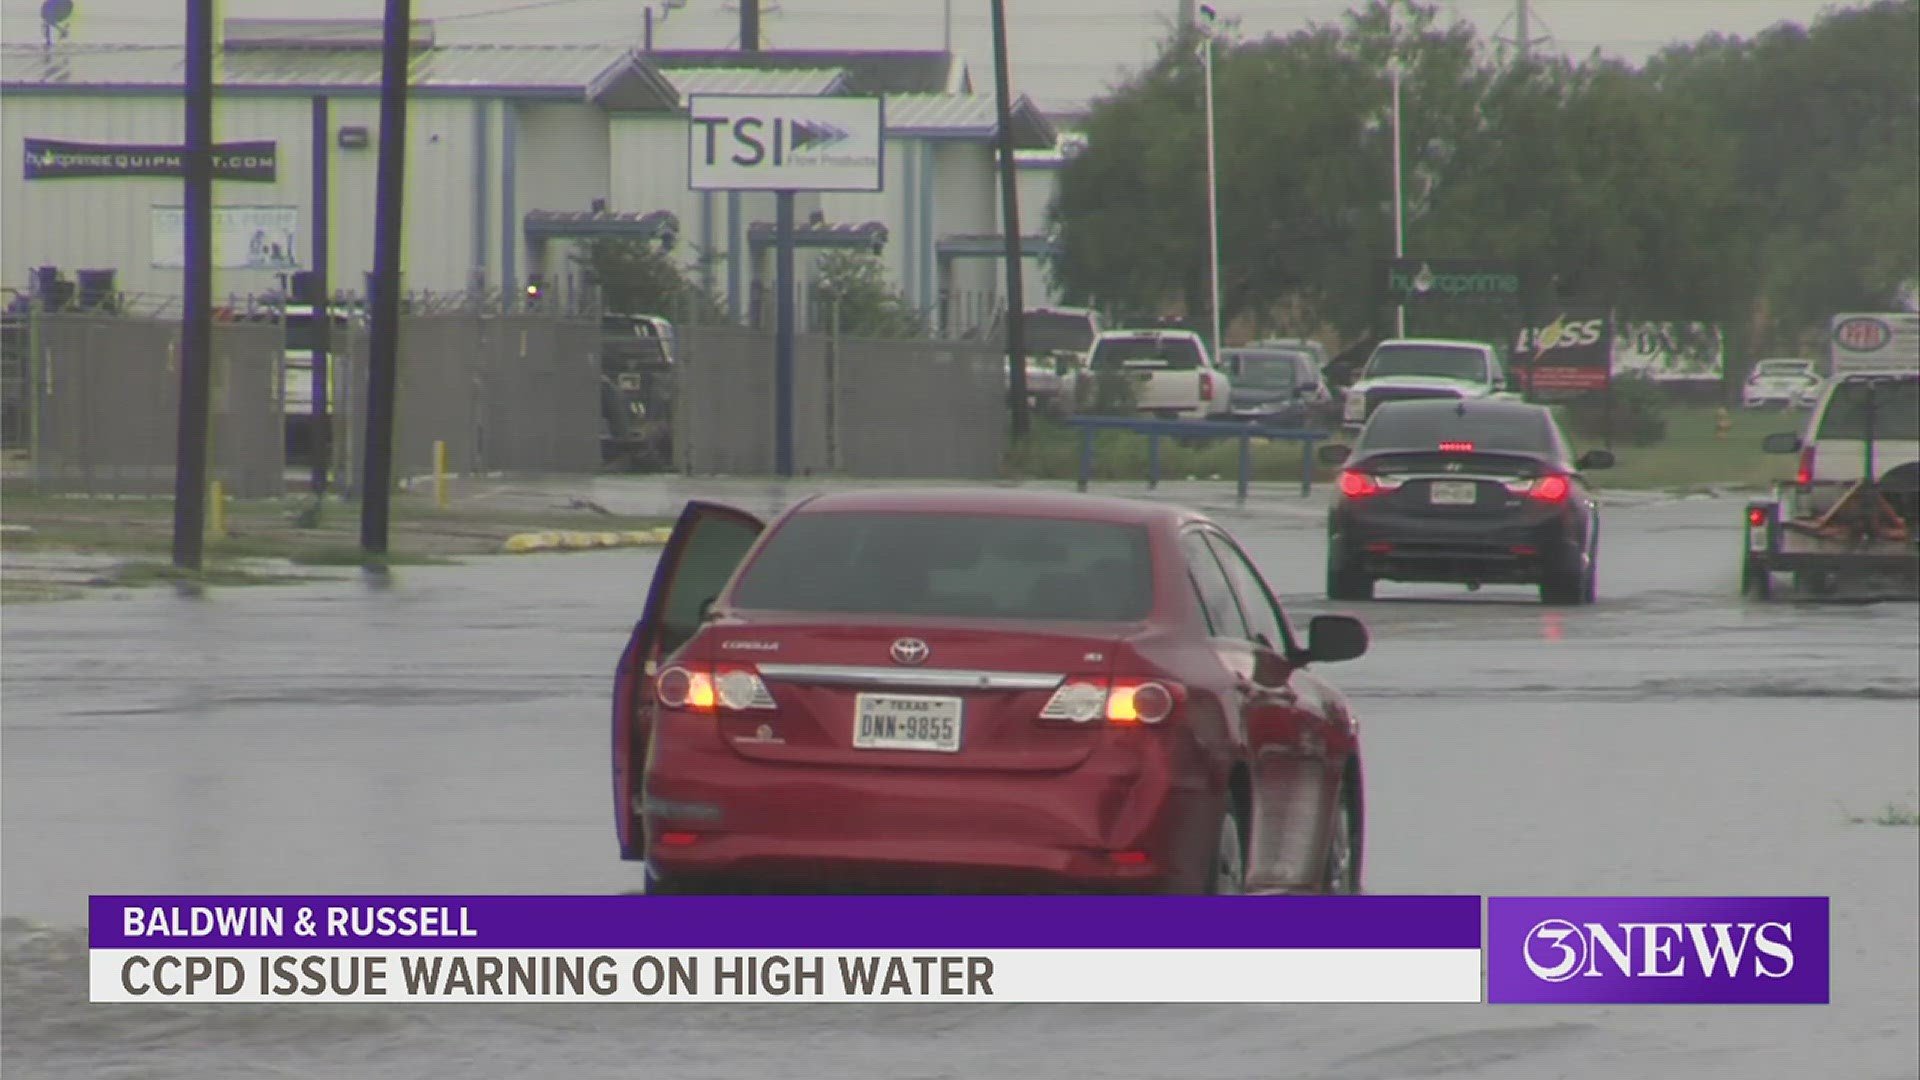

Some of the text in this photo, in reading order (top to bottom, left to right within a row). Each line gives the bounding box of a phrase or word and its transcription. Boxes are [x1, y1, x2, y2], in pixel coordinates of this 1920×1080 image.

[692, 116, 784, 166] TSI
[889, 701, 929, 711] TEXAS
[862, 715, 953, 739] DNN-9855
